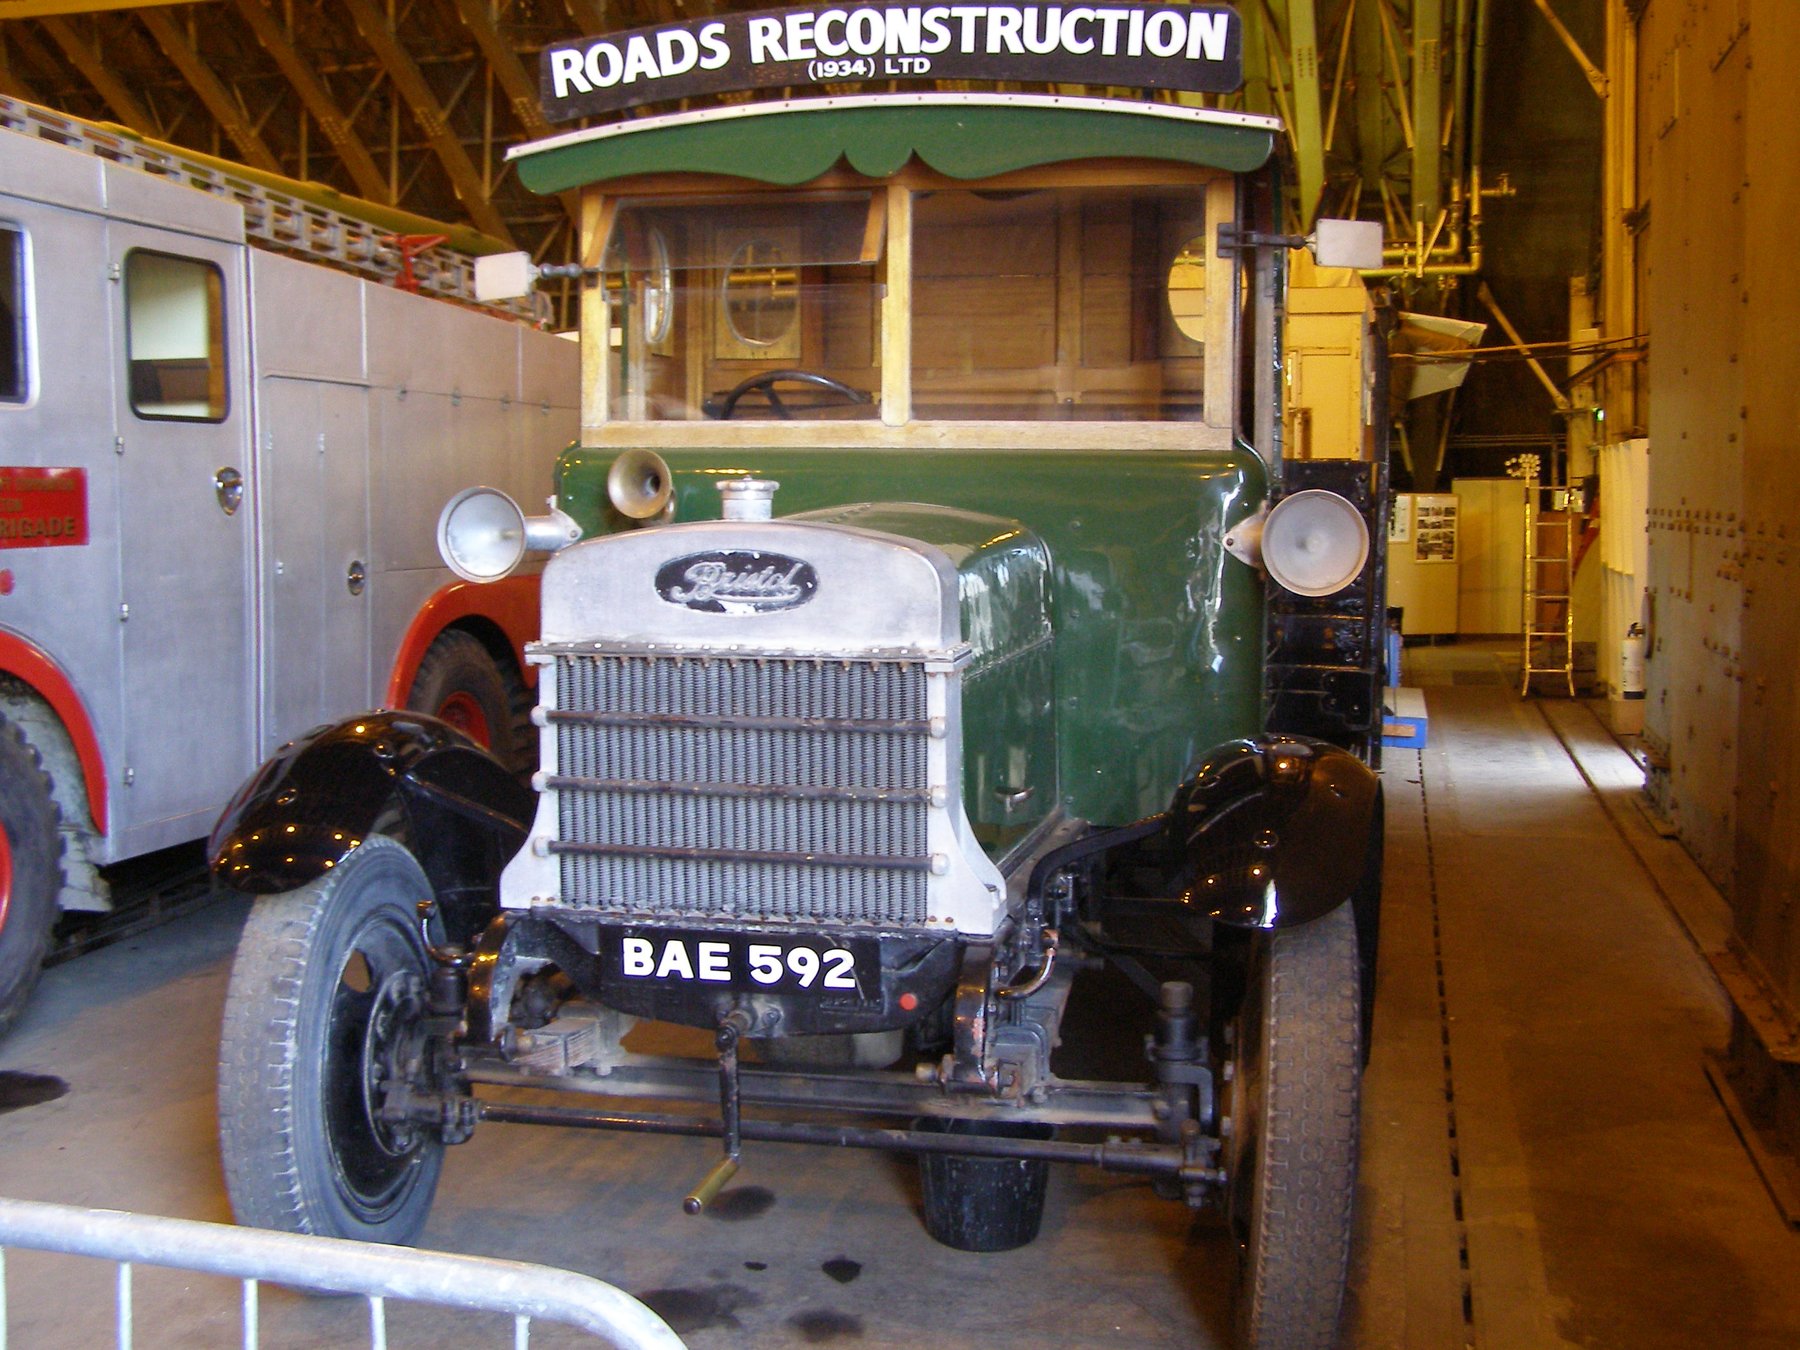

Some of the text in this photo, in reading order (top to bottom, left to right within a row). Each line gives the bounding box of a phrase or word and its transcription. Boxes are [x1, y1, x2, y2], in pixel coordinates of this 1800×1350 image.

[551, 6, 1229, 98] ROADS RECONSTRUCTION
[807, 56, 931, 80] (1934) LTD
[622, 937, 856, 988] BAE 592
